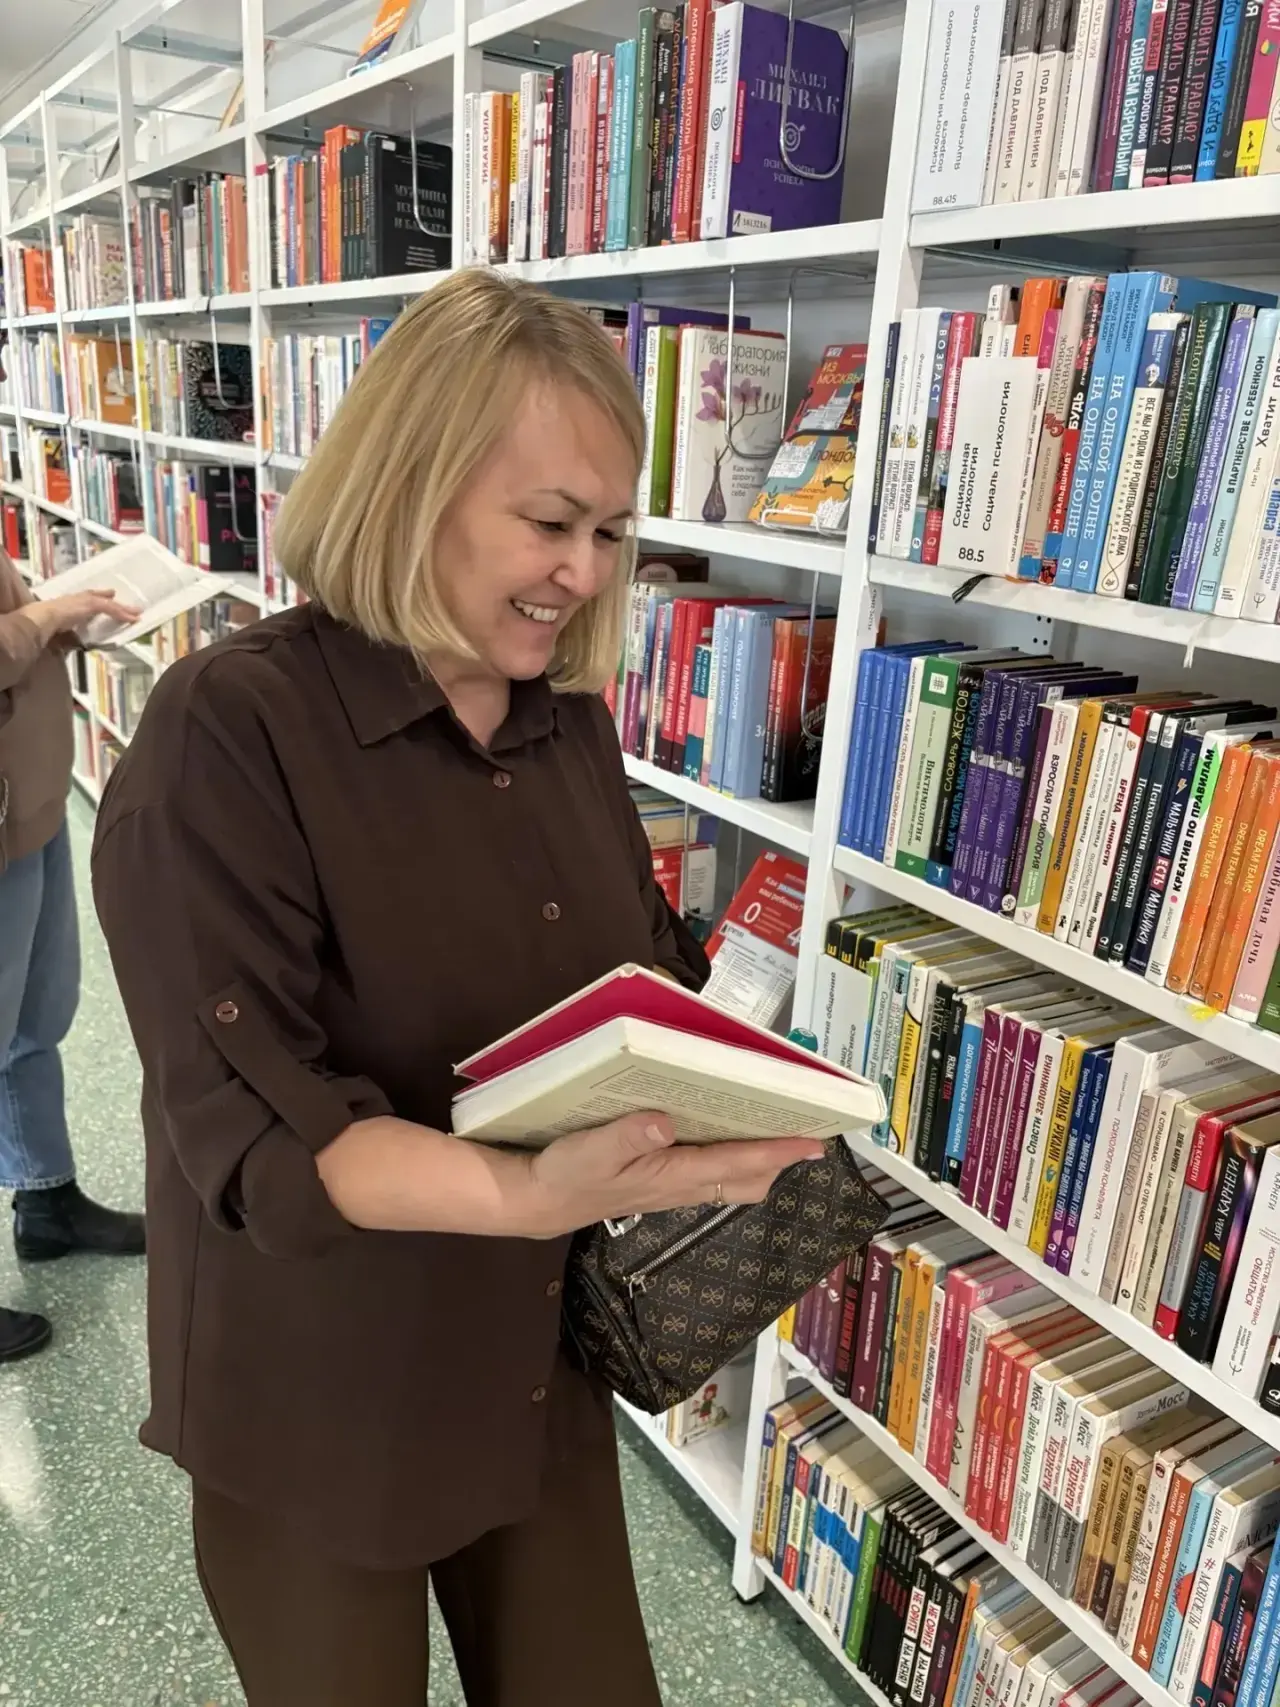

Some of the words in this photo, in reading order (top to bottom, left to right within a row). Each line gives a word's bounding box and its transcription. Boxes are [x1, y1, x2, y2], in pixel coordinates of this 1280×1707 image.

[966, 4, 980, 89] психологиясе
[929, 104, 943, 173] Психология
[940, 10, 954, 100] подросткового
[937, 120, 948, 172] возраста
[1004, 99, 1022, 168] ДАВЛЕНИЕМ
[1030, 98, 1046, 168] ДАВЛЕНИЕМ
[1068, 392, 1084, 430] БУДЬ
[1091, 376, 1105, 401] НА
[1109, 375, 1125, 401] НА
[983, 470, 999, 531] Социаль
[993, 381, 1011, 467] психология
[1078, 408, 1099, 473] ОДНОЙ
[1096, 408, 1117, 473] ОДНОЙ
[953, 443, 971, 527] Социальная
[962, 447, 979, 528] психология
[1067, 478, 1086, 539] ВОЛНЕ
[1084, 478, 1104, 540] ВОЛНЕ
[958, 547, 984, 562] 88.5
[951, 689, 969, 742] ЖЕСТОВ
[944, 742, 959, 792] СЛОВАРЬ
[914, 759, 937, 843] Виктимология
[1053, 787, 1077, 871] Эмоциональный
[1067, 730, 1089, 787] интеллект
[1173, 840, 1193, 892] КРЕАТИВ
[1191, 748, 1216, 819] ПРАВИЛАМ
[1026, 1115, 1042, 1156] Спасти
[1036, 1054, 1054, 1116] заложника
[1217, 1157, 1240, 1217] КАРНЕГИ
[1040, 1435, 1060, 1490] Карнеги
[1064, 1456, 1083, 1512] Карнеги
